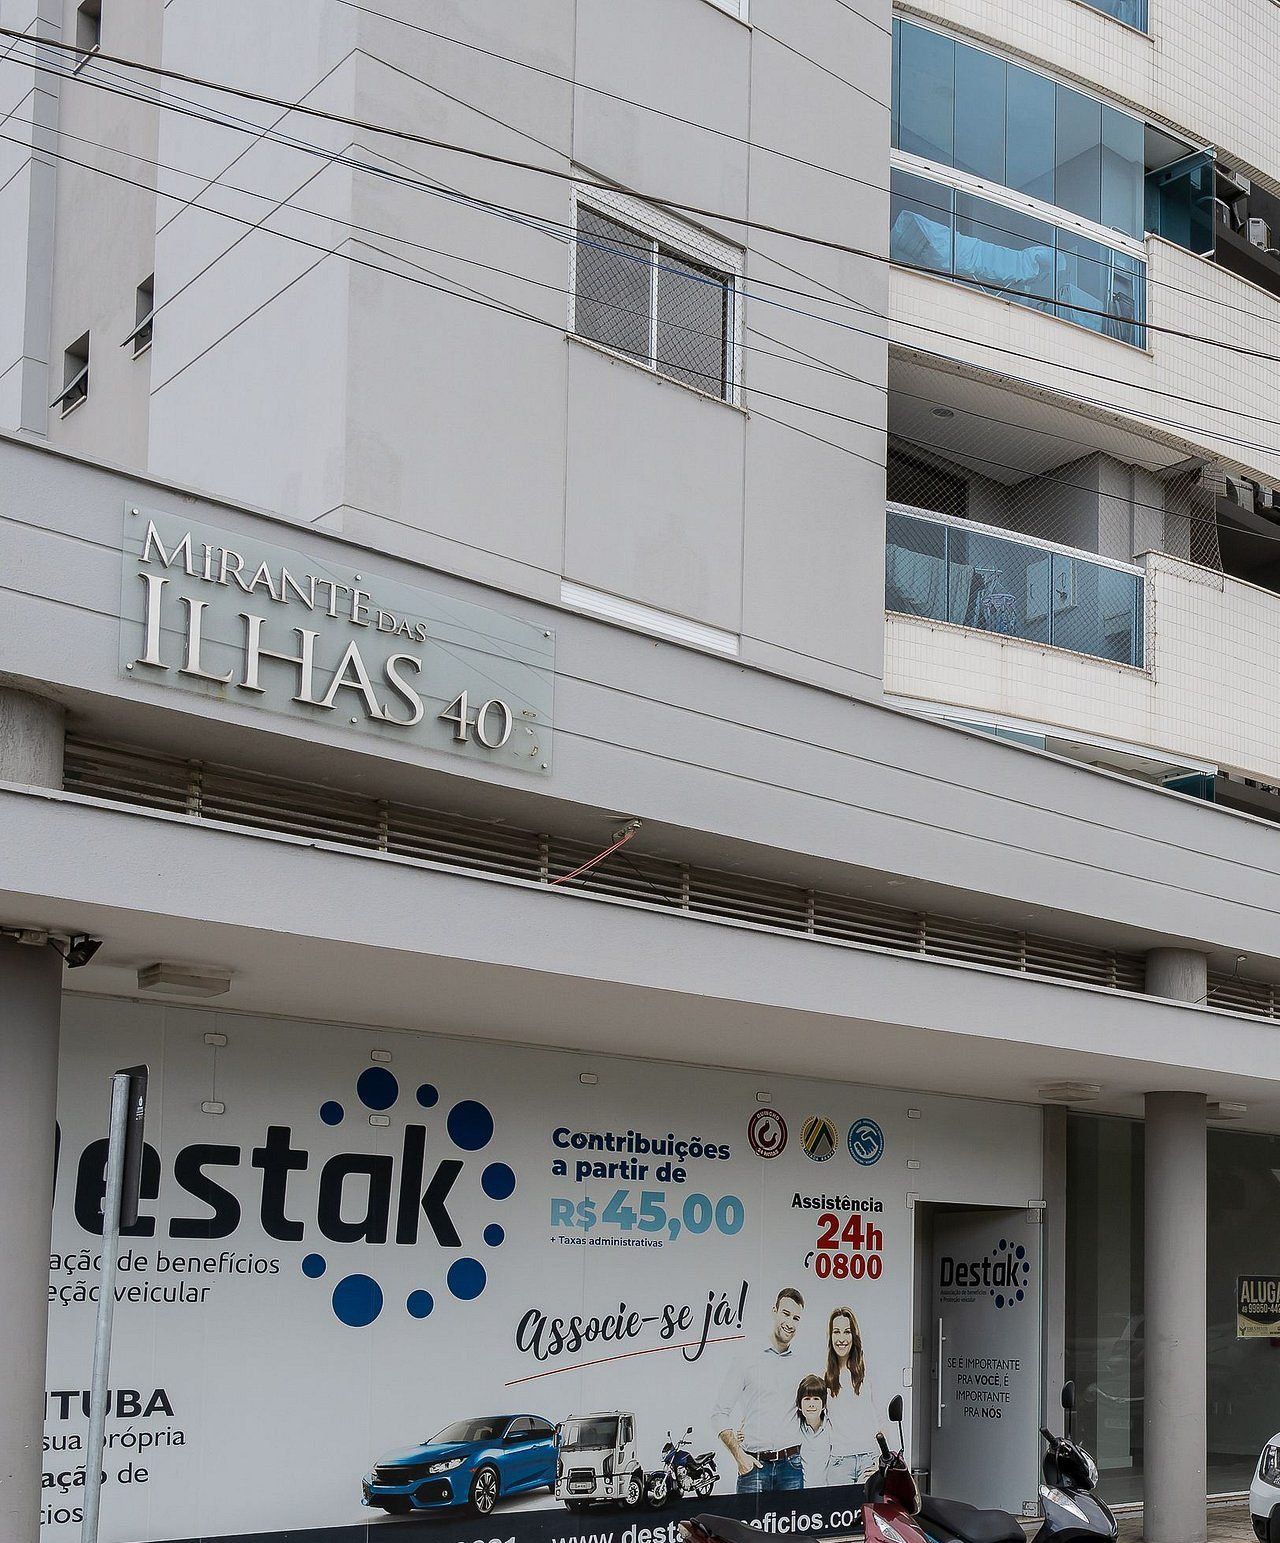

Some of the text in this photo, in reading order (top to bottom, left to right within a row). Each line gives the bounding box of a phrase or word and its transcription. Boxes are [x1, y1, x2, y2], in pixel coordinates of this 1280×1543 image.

[376, 609, 427, 643] DAS
[136, 572, 513, 749] ILHAS 40
[552, 1127, 731, 1162] Contribuições
[551, 1157, 687, 1183] a partir de
[52, 1120, 464, 1247] estak
[550, 1189, 745, 1241] R$ 45,00
[791, 1192, 883, 1213] Assistência
[559, 1235, 587, 1245] Taxas
[588, 1236, 663, 1248] administrativas
[816, 1213, 883, 1250] 24h
[117, 1250, 148, 1272] de
[156, 1250, 280, 1274] benefícios
[815, 1252, 882, 1279] 0800
[940, 1253, 1020, 1287] Destak
[113, 1281, 211, 1303] veicular
[515, 1279, 749, 1362] Associe-se já!
[947, 1355, 1020, 1370] SE É IMPORTANTE
[957, 1374, 973, 1385] PRA
[1004, 1373, 1009, 1386] É
[956, 1390, 1010, 1403] IMPORTANTE
[964, 1405, 1002, 1418] PRA NÓS
[102, 1426, 186, 1454] rópria
[117, 1462, 149, 1484] de
